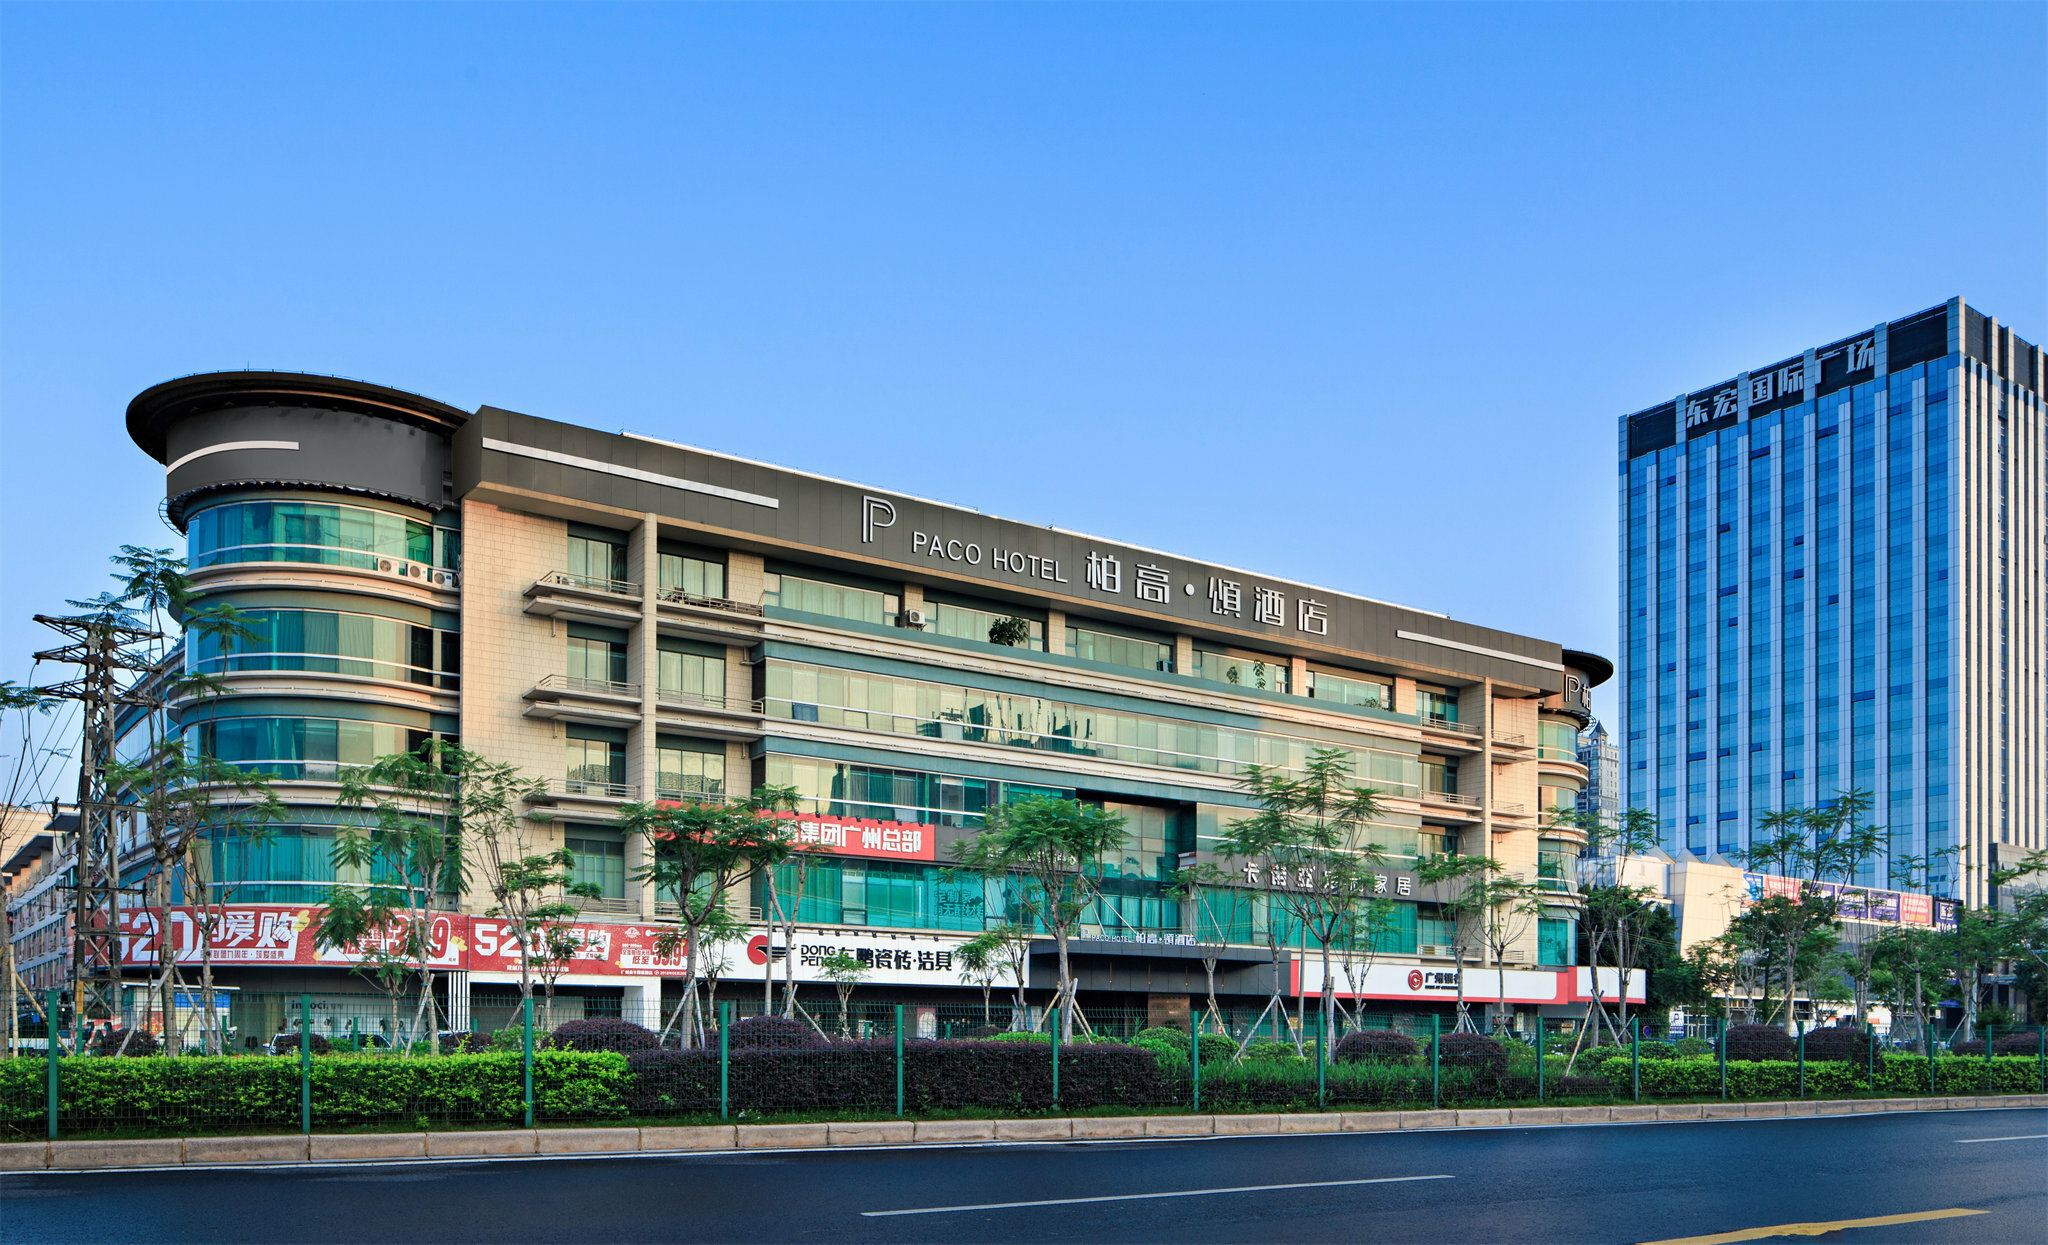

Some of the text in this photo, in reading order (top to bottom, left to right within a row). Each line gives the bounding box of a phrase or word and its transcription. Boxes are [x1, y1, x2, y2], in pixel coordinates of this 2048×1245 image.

[1686, 336, 1875, 428] 东宏国际广场
[861, 495, 896, 543] P
[912, 531, 982, 565] PACO
[992, 547, 1068, 583] HOTEL
[632, 956, 650, 965] 低至
[801, 956, 837, 967] PEN
